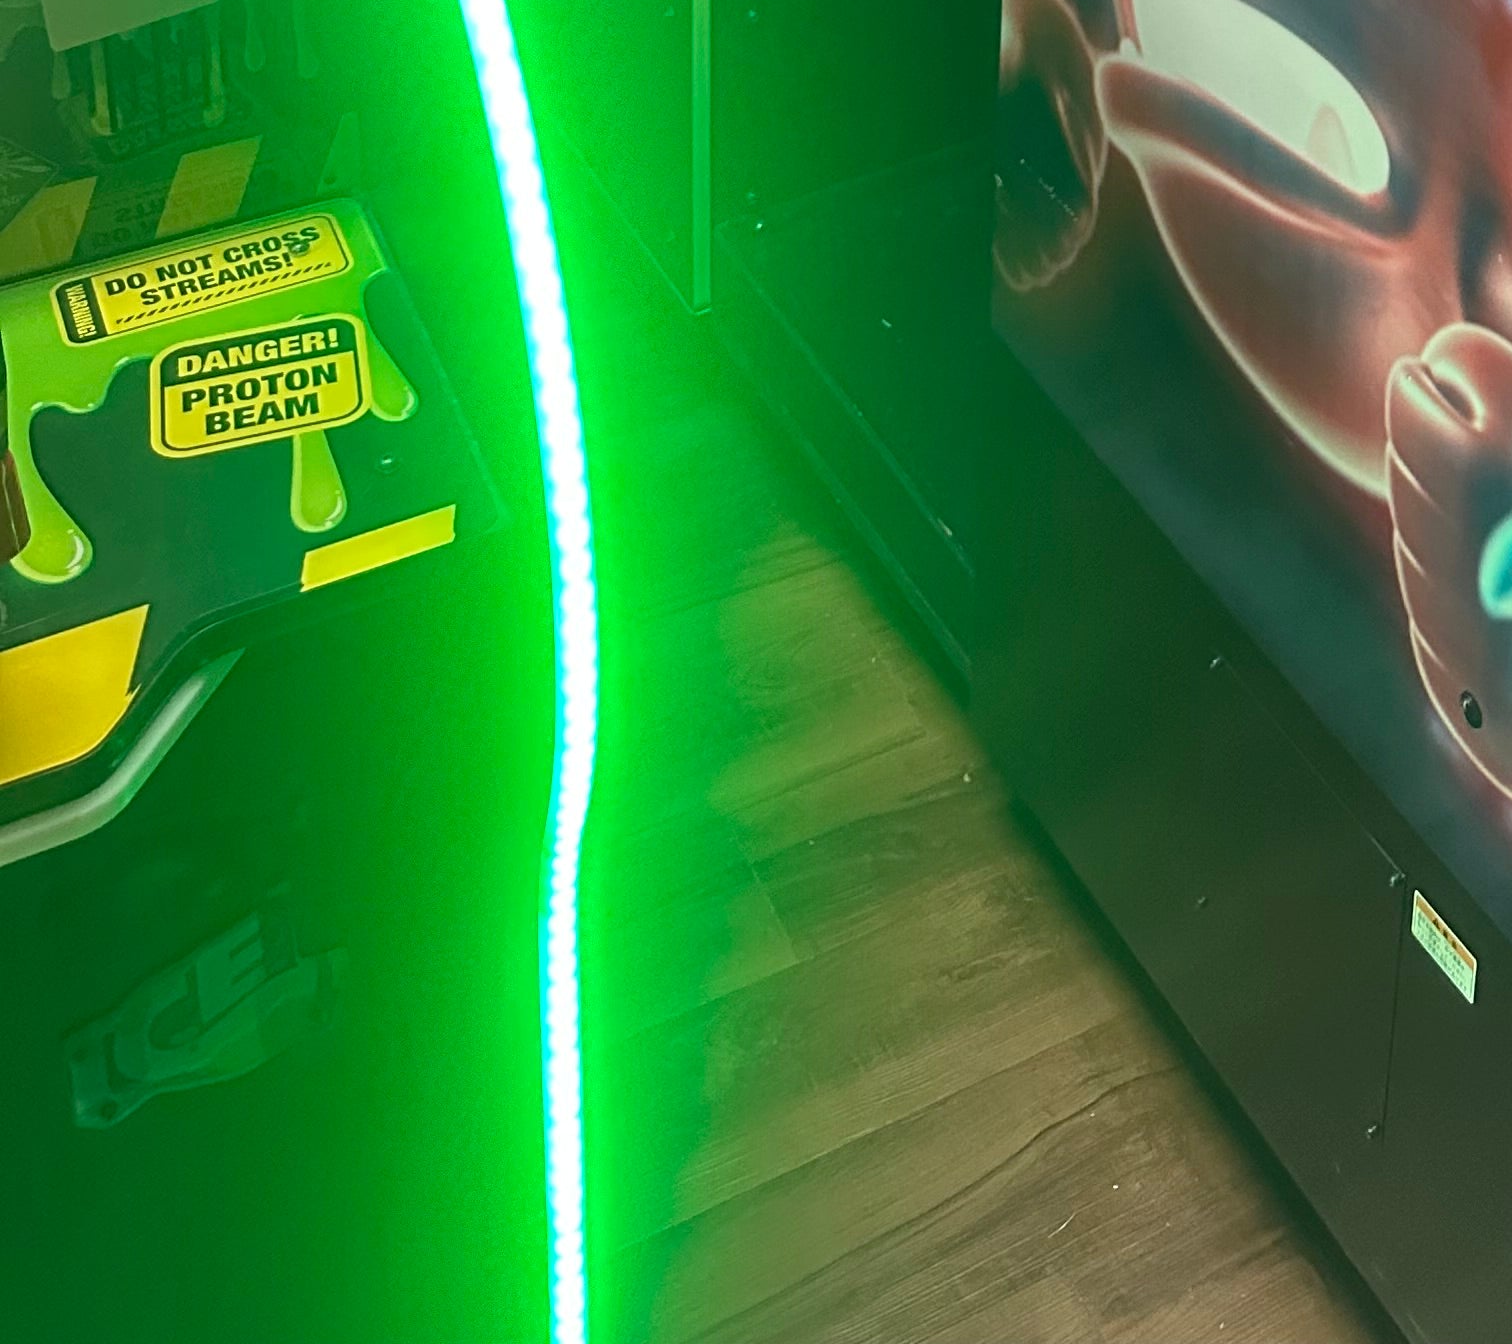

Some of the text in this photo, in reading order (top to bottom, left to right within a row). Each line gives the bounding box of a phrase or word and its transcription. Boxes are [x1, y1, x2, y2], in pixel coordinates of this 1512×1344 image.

[104, 226, 321, 297] DO NOT CROSS
[140, 252, 293, 306] STREAMS!
[65, 284, 98, 339] WARNING!
[176, 328, 340, 378] DANGER!
[181, 362, 338, 413] PROTON
[205, 393, 320, 437] BEAM
